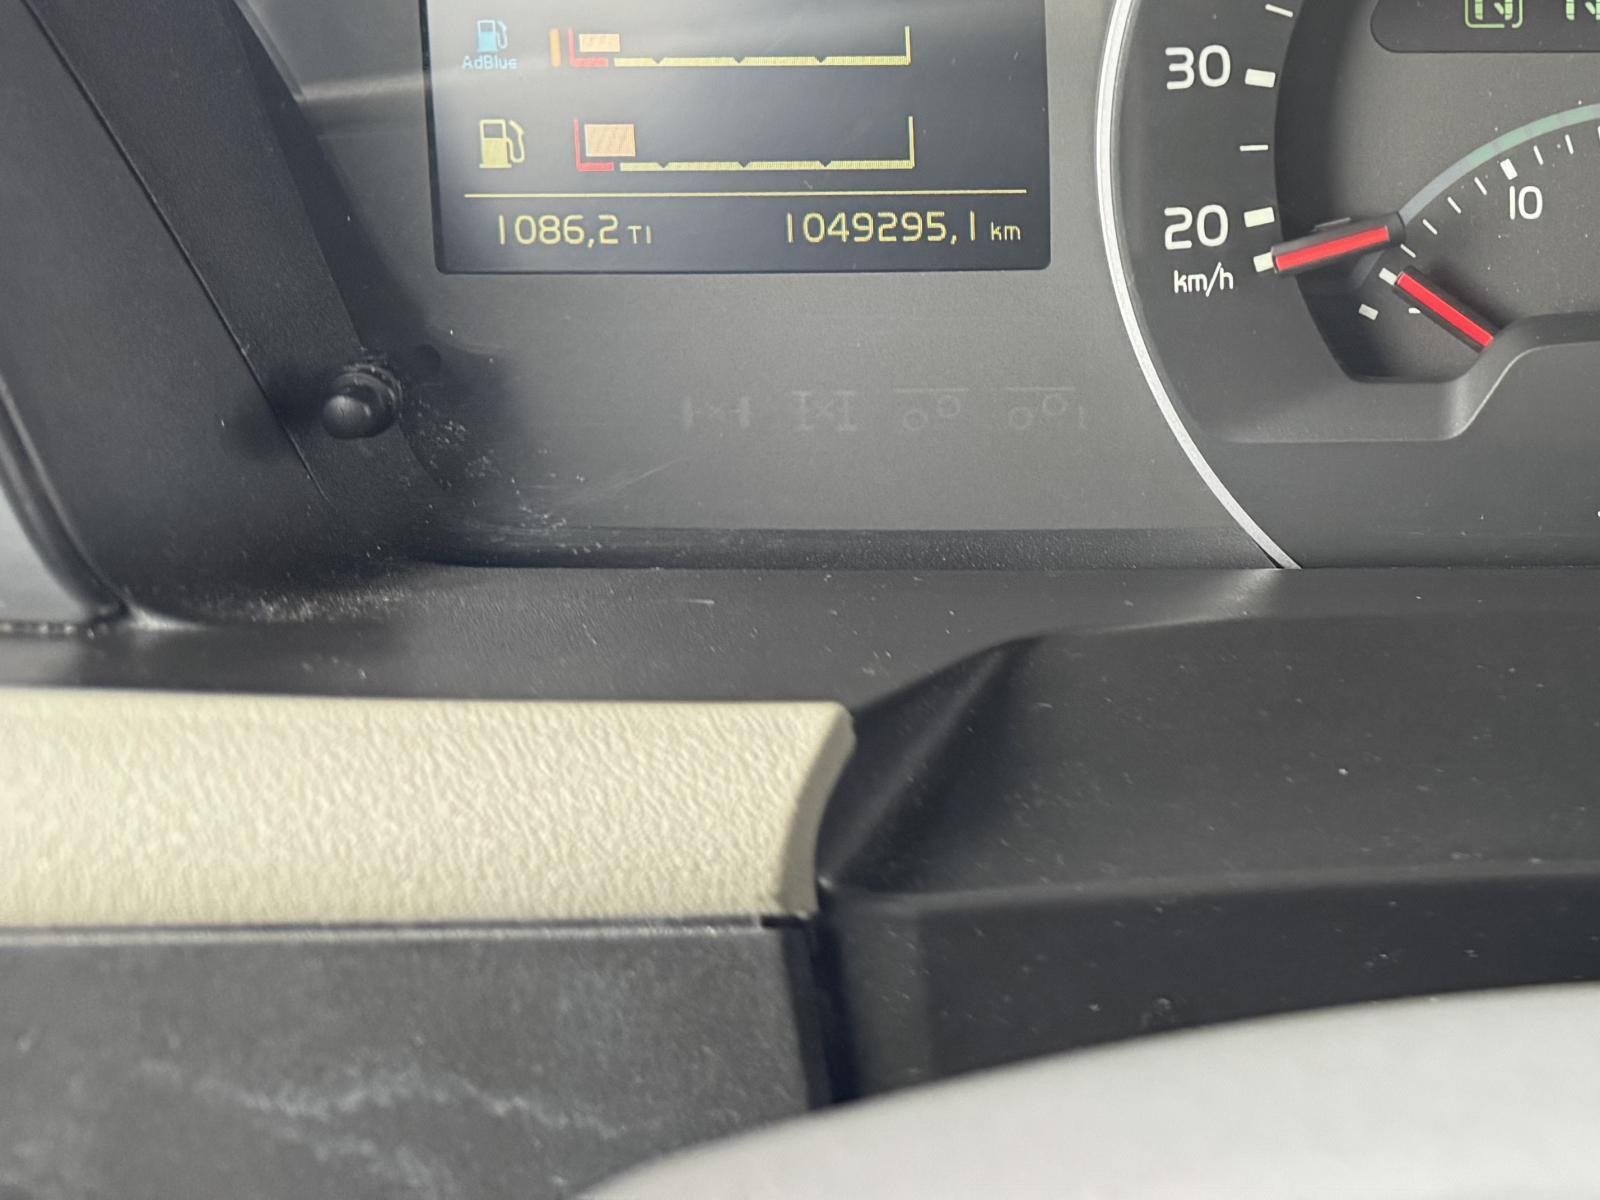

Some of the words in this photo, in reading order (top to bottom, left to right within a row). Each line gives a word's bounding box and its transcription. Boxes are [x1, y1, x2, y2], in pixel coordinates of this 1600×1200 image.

[461, 54, 518, 71] AdBlue
[1164, 44, 1232, 90] 30
[1508, 185, 1545, 221] 10
[498, 212, 621, 250] 1086,2
[785, 210, 978, 247] 1049295,1
[990, 221, 1022, 242] km
[1163, 203, 1230, 251] 20
[1172, 261, 1235, 298] km/h
